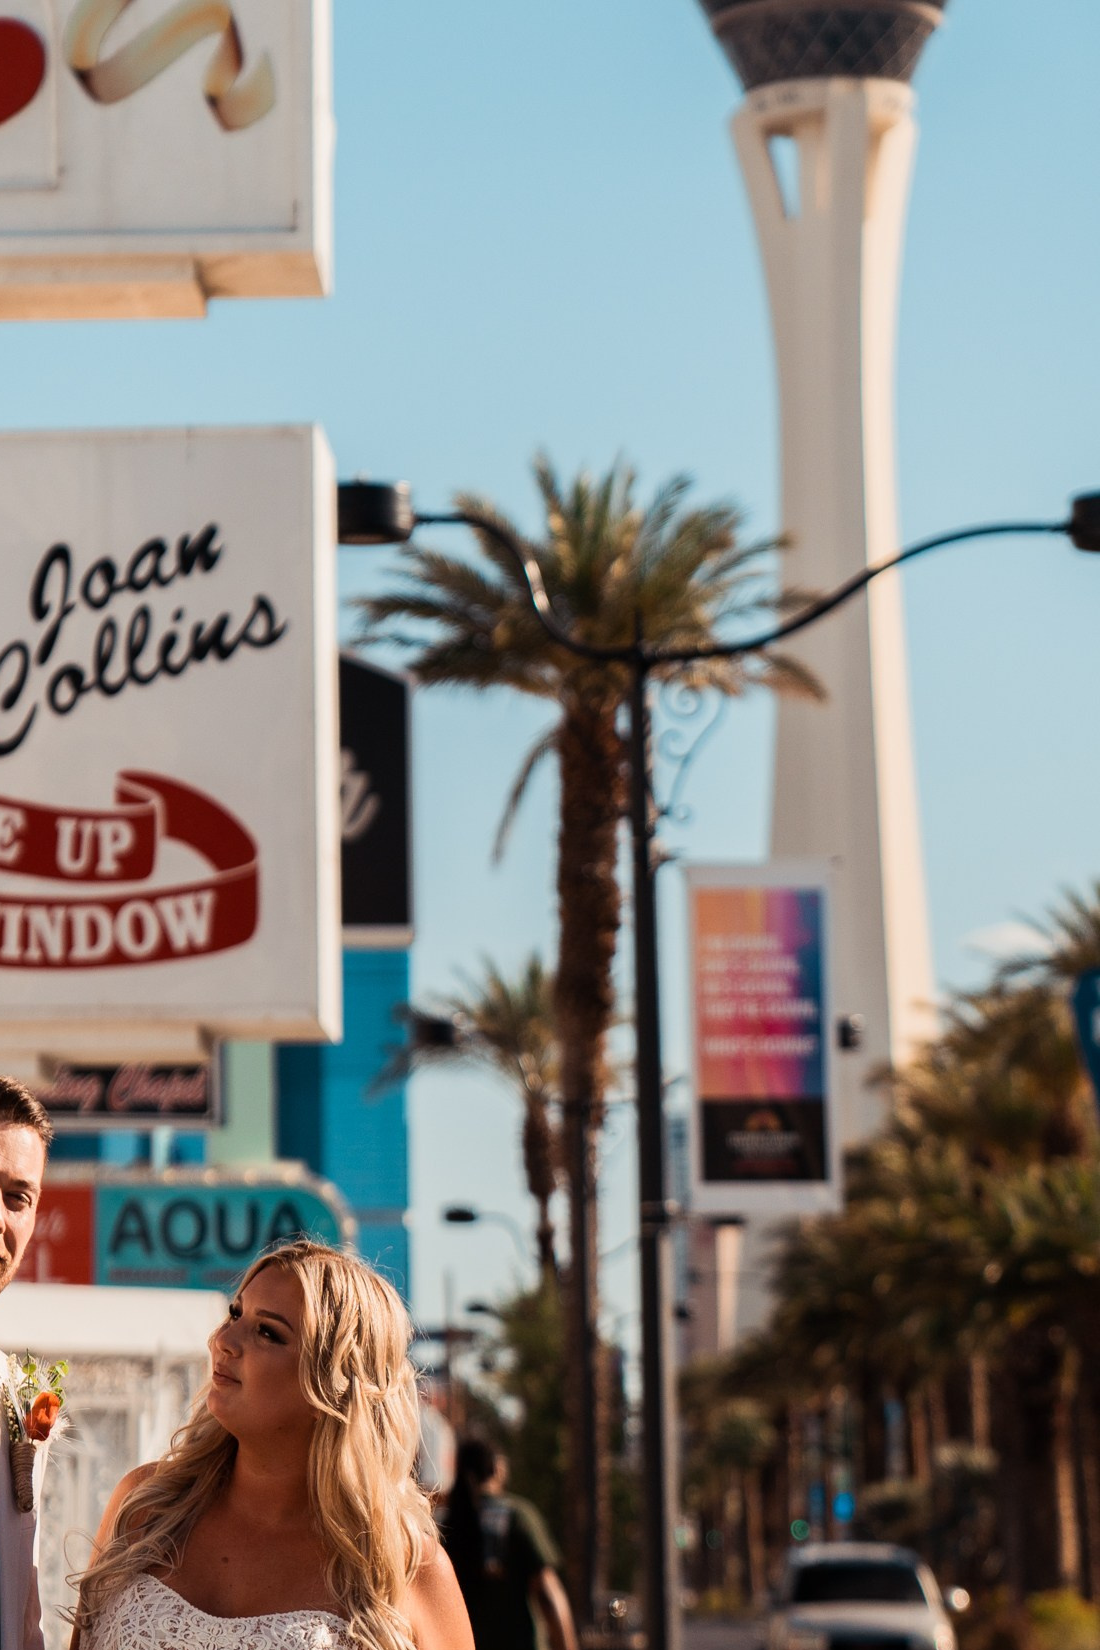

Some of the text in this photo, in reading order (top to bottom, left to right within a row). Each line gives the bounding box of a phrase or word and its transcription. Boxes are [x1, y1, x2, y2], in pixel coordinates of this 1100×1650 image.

[29, 521, 225, 666] Joan
[54, 816, 135, 878] UP
[109, 1197, 308, 1261] AQUA
